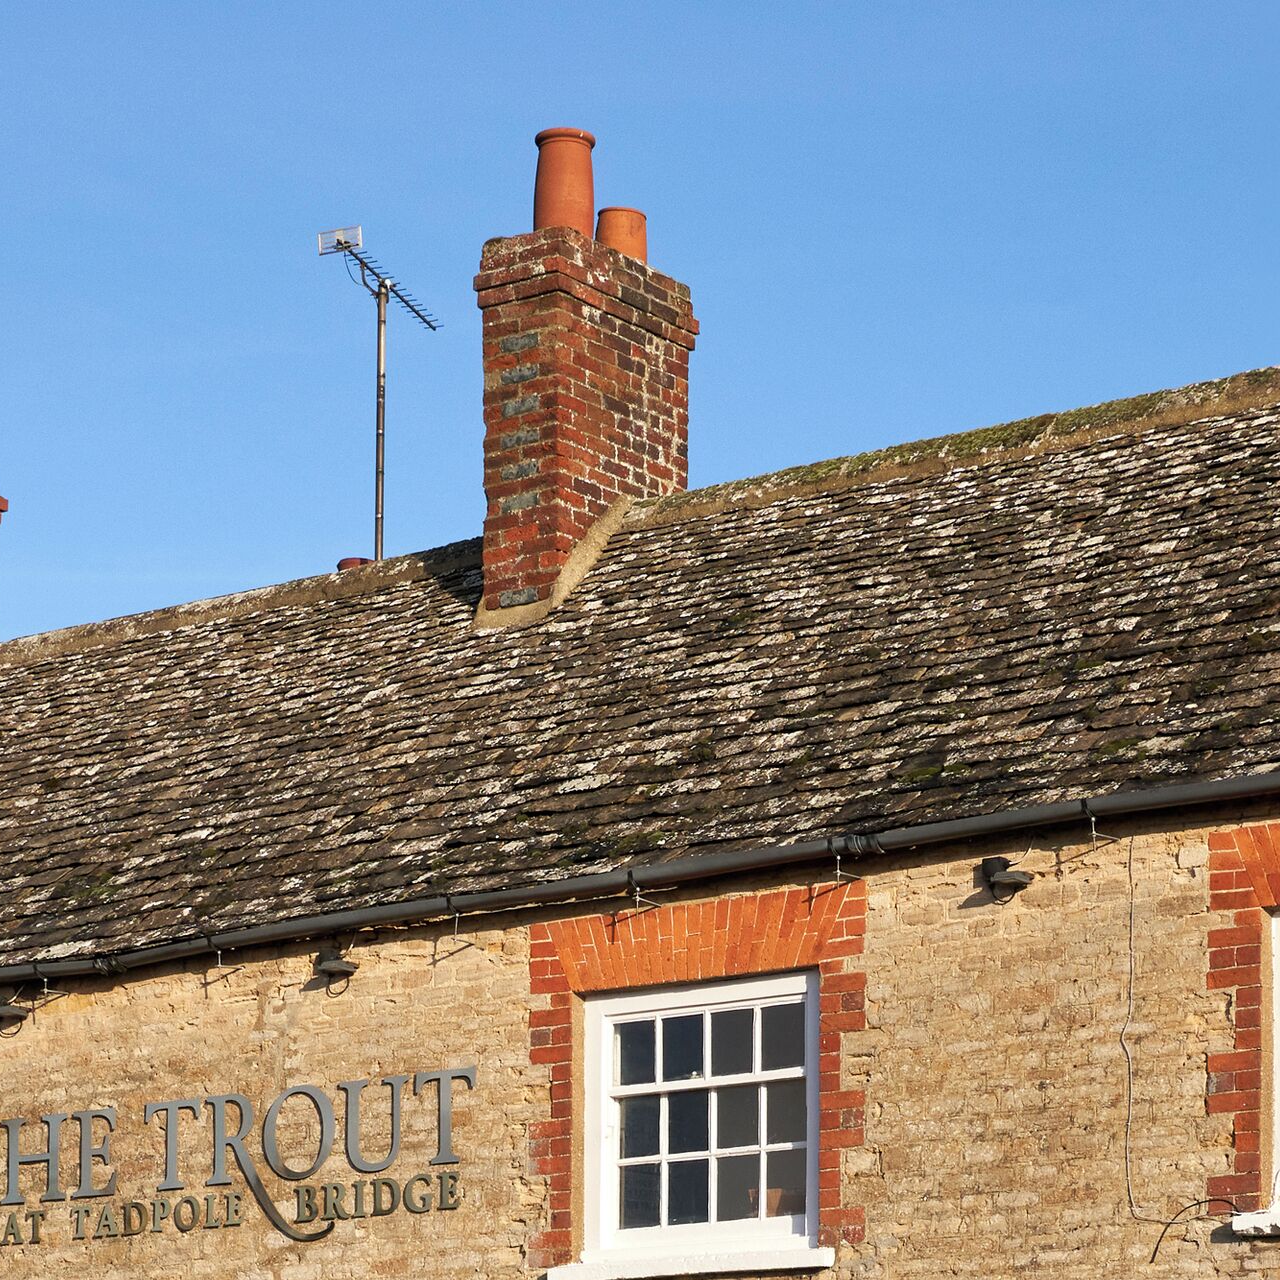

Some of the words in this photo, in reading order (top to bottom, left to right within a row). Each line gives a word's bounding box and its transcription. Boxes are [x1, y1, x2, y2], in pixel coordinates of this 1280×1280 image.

[0, 1213, 47, 1246] AT
[71, 1193, 244, 1240] TADPOLE
[294, 1171, 461, 1224] BRIDGE
[143, 1065, 477, 1241] TROUT
